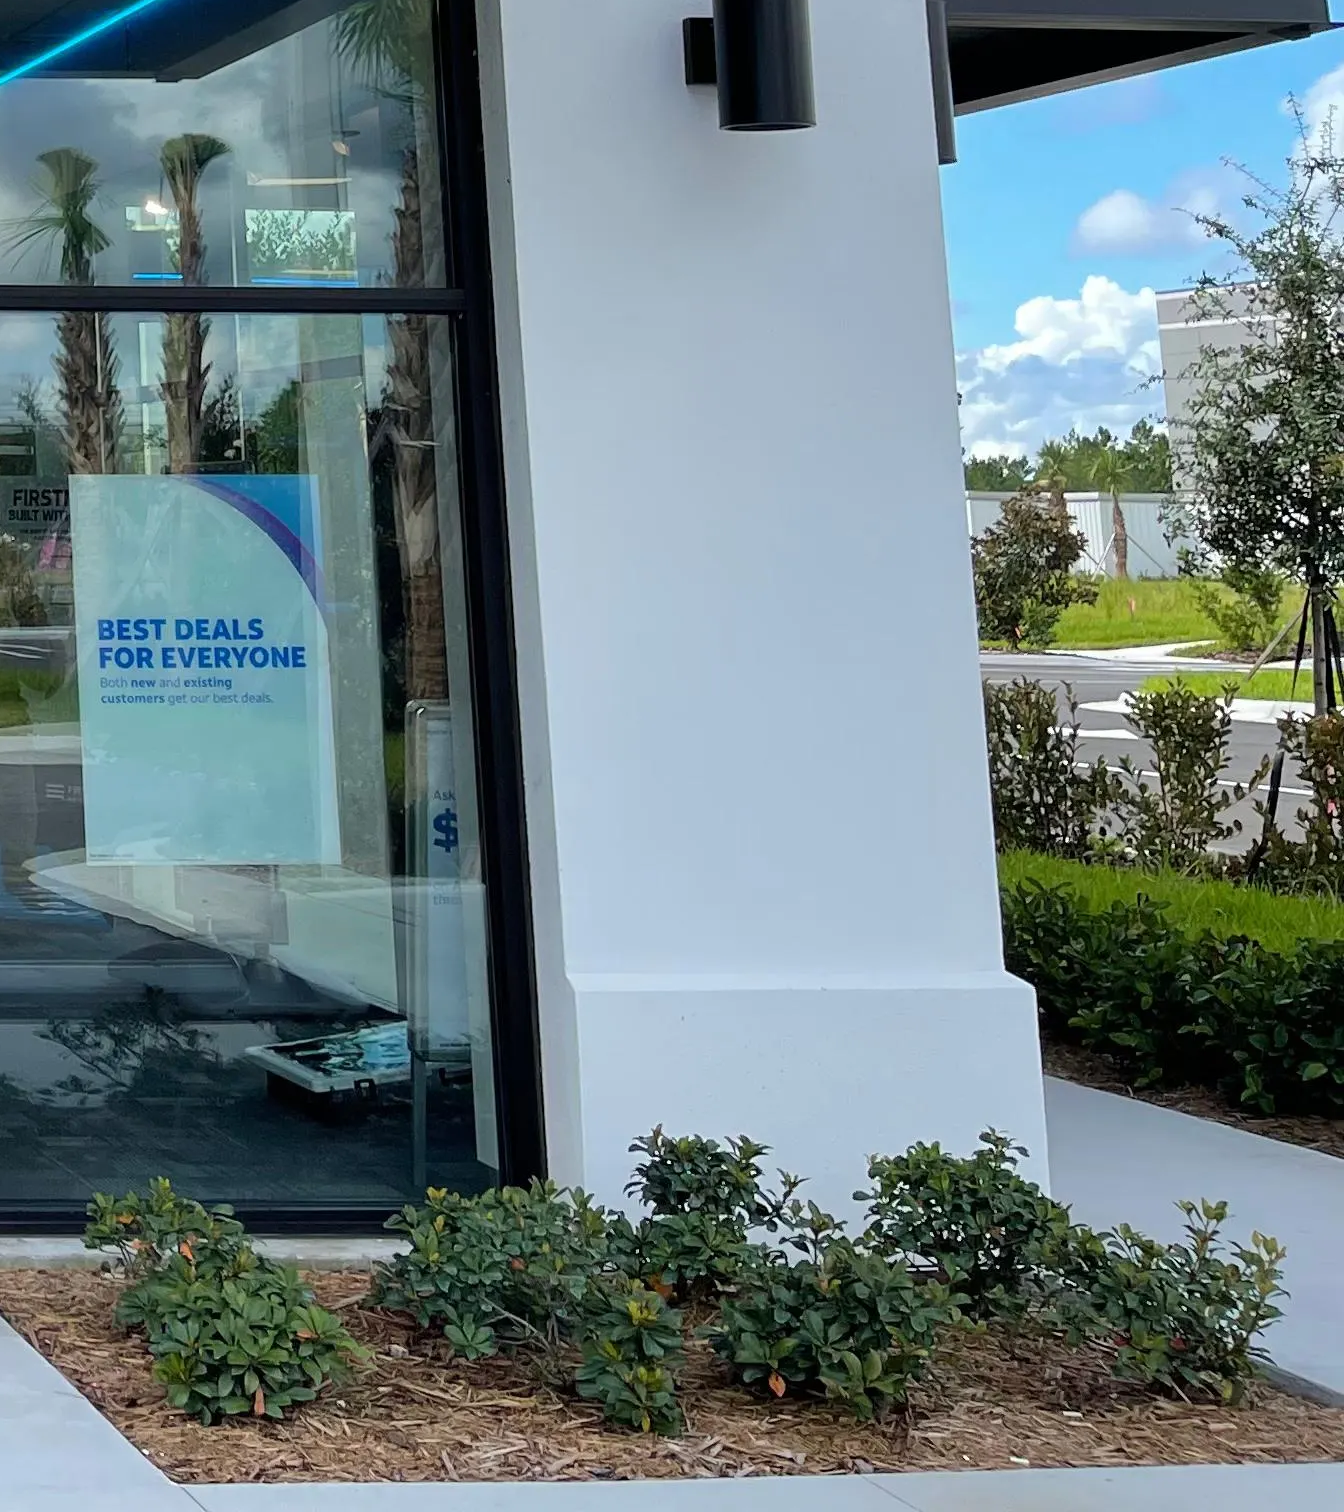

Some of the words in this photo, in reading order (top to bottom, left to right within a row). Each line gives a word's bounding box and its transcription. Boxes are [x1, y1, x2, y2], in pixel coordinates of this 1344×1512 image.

[8, 509, 39, 521] BUILT
[97, 619, 167, 641] BEST
[175, 619, 264, 641] DEALS
[99, 647, 154, 669] FOR
[162, 646, 307, 669] EVERYONE
[99, 677, 128, 689] Both
[131, 679, 156, 689] new
[159, 677, 181, 689] and
[183, 676, 233, 691] existing
[101, 694, 166, 704] customers
[167, 694, 187, 706] get
[190, 695, 209, 704] our
[212, 693, 239, 704] best
[241, 693, 274, 704] deals.
